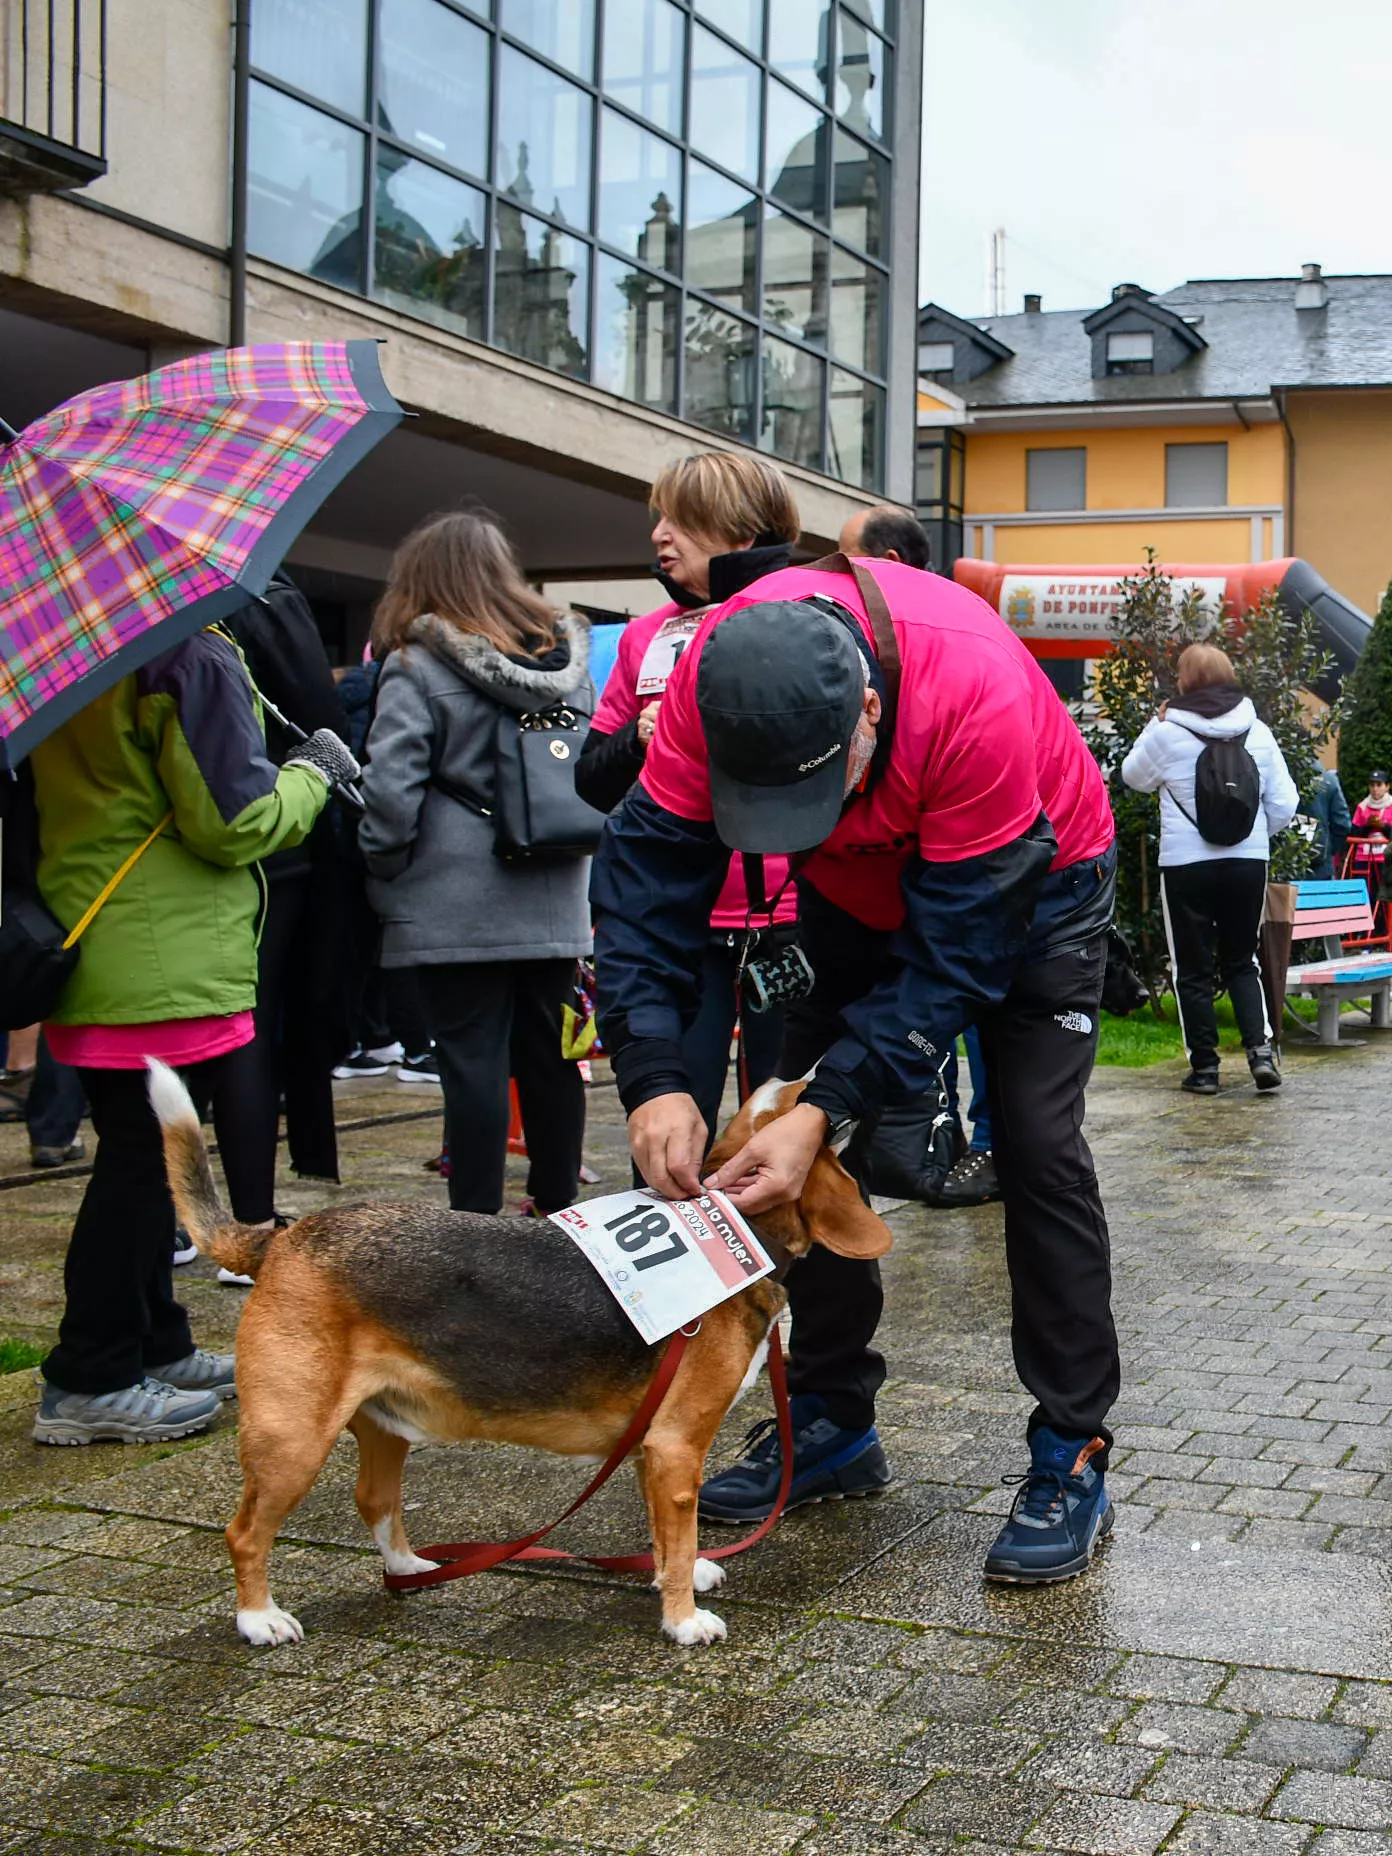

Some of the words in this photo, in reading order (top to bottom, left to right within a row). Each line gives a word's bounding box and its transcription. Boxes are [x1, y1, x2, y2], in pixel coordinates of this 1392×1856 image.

[1048, 584, 1121, 596] AYUNTAM
[1043, 601, 1064, 614] DE
[807, 743, 841, 768] Columbia
[1053, 1014, 1081, 1024] NORTH
[1067, 1010, 1081, 1018] THE
[1061, 1020, 1081, 1031] FACE
[684, 1209, 710, 1237] 2024
[603, 1205, 689, 1271] 187
[706, 1208, 722, 1222] la
[717, 1223, 753, 1265] mujer
